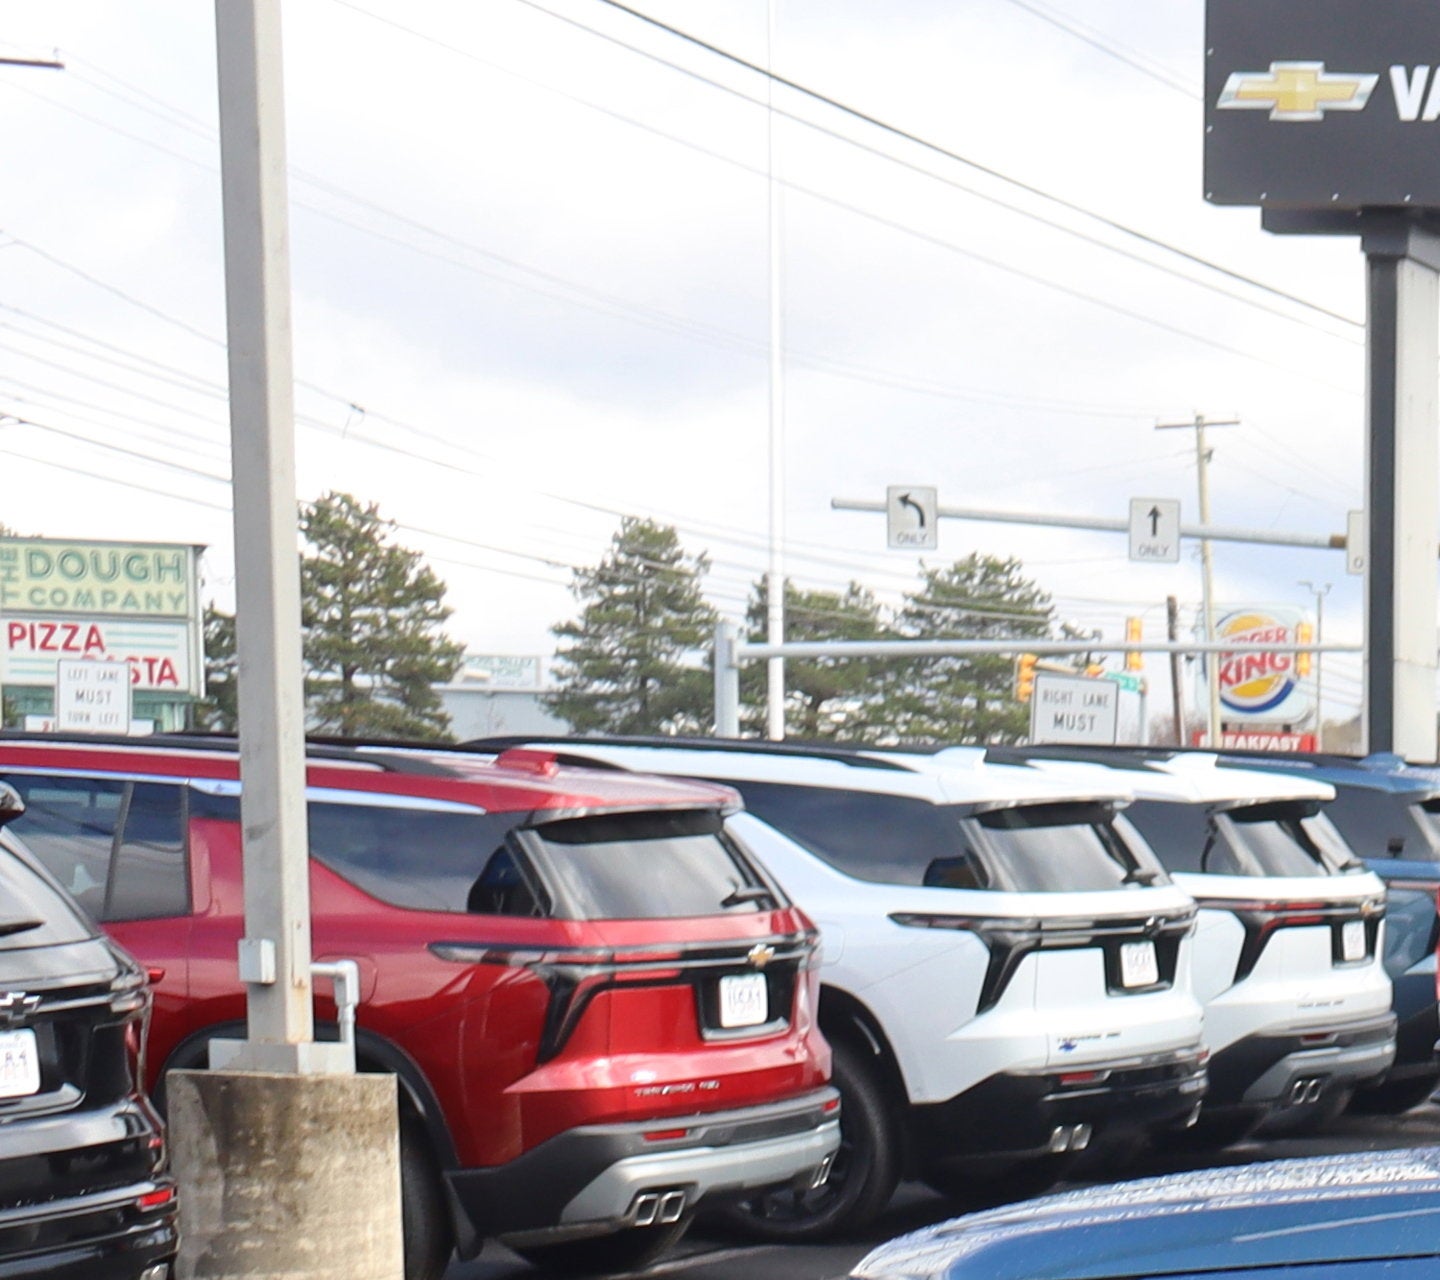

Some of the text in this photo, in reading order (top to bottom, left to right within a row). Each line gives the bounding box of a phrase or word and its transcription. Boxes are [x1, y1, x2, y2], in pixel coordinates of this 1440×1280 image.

[896, 532, 928, 545] ONLY
[1138, 543, 1170, 557] ONLY
[25, 547, 187, 584] DOUGH
[28, 586, 186, 611] COMPANY
[8, 621, 105, 654] PIZZA
[80, 653, 179, 687] STA
[75, 689, 112, 705] MUST
[1043, 688, 1109, 708] RIGHT LANE
[1053, 712, 1096, 733] MUST
